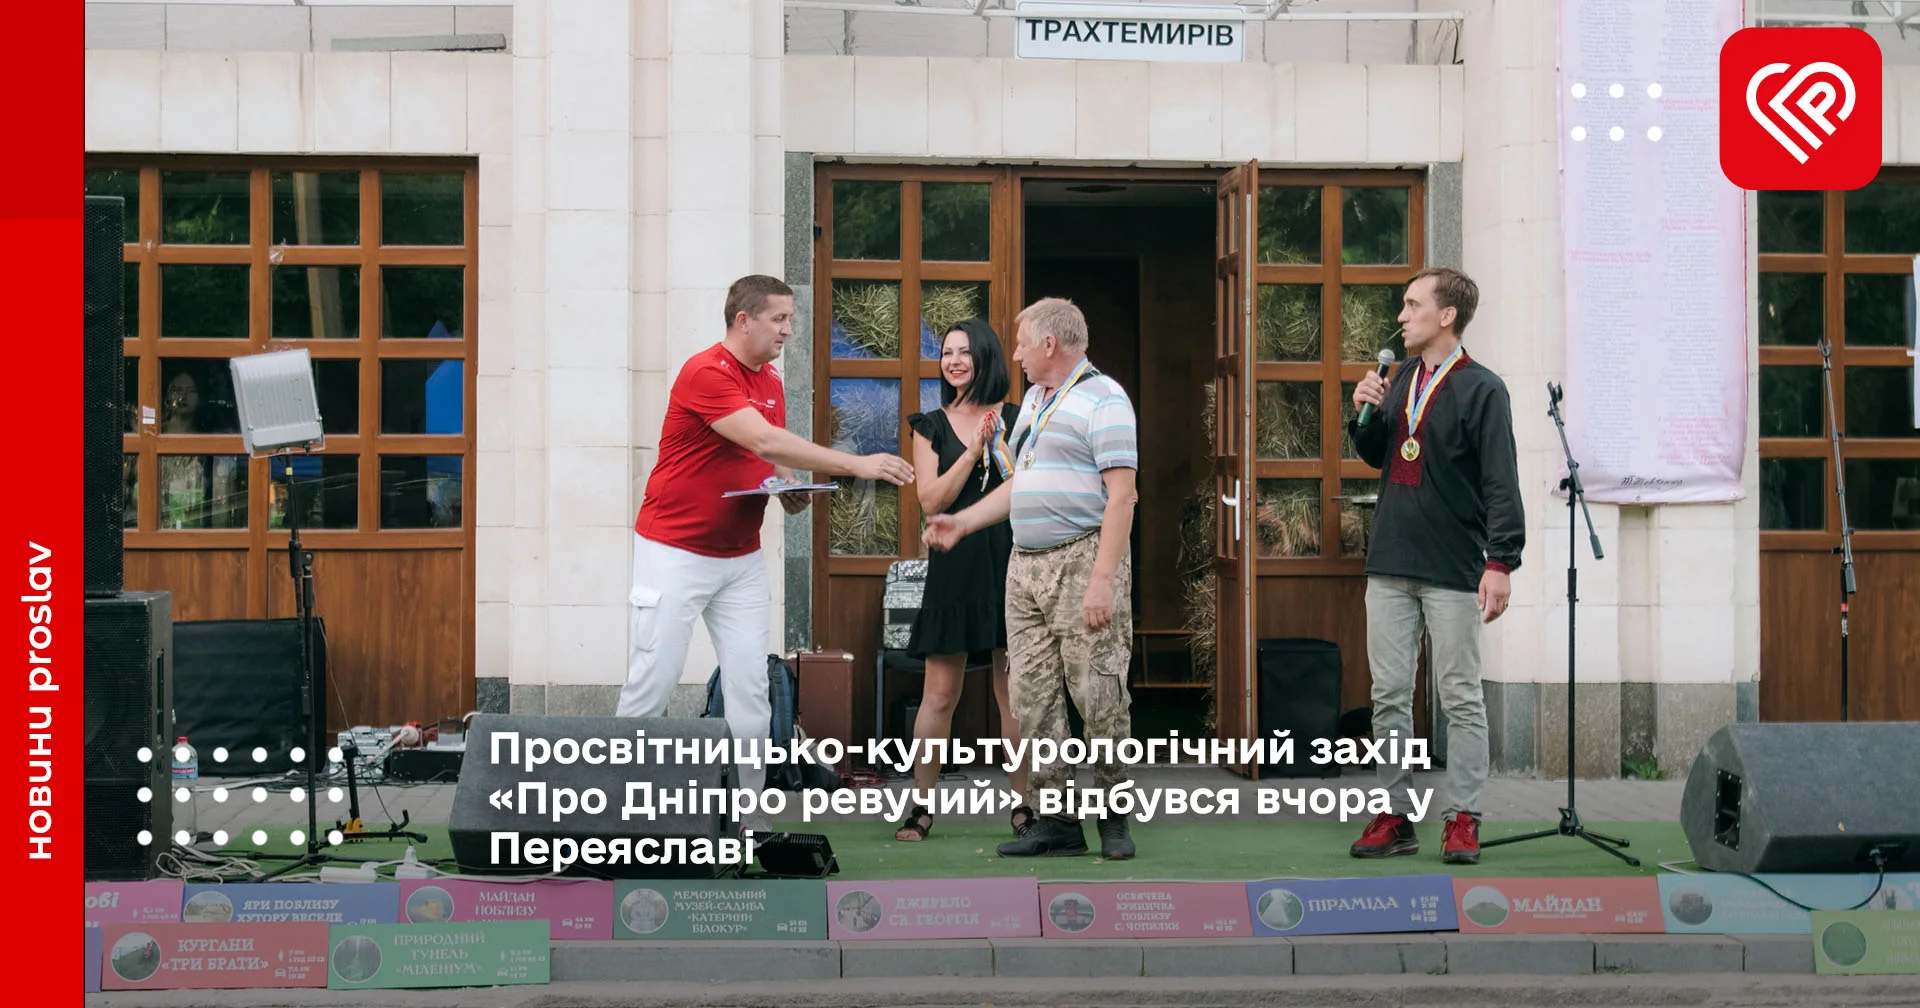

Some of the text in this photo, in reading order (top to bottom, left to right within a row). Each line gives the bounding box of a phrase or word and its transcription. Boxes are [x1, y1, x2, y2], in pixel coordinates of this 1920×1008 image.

[1025, 18, 1234, 46] ТРАХТЕМИРІВ
[478, 890, 536, 904] МАЙДАН
[673, 888, 767, 900] МЕМОРІАЛЬНИЙ
[273, 898, 340, 911] ПОБЛИЗУ
[475, 904, 537, 918] ПОБЛИЗУ
[674, 900, 766, 912] МУЗЕЙ-САДИБА
[895, 896, 973, 911] ДЖЕРЕЛО
[1308, 895, 1399, 913] ПІРАМІДА
[1512, 893, 1603, 914] МАЙДАН
[888, 911, 981, 927] СВ. ГЕОРГІЯ
[176, 937, 255, 953] КУРГАНИ
[393, 930, 487, 948] ПРИРОДНИЙ
[410, 947, 469, 961] ТУНЕЛЬ
[161, 956, 270, 972] «ТРИ БРАТИ»
[395, 962, 484, 977] «МІЛЕНІУМ»
